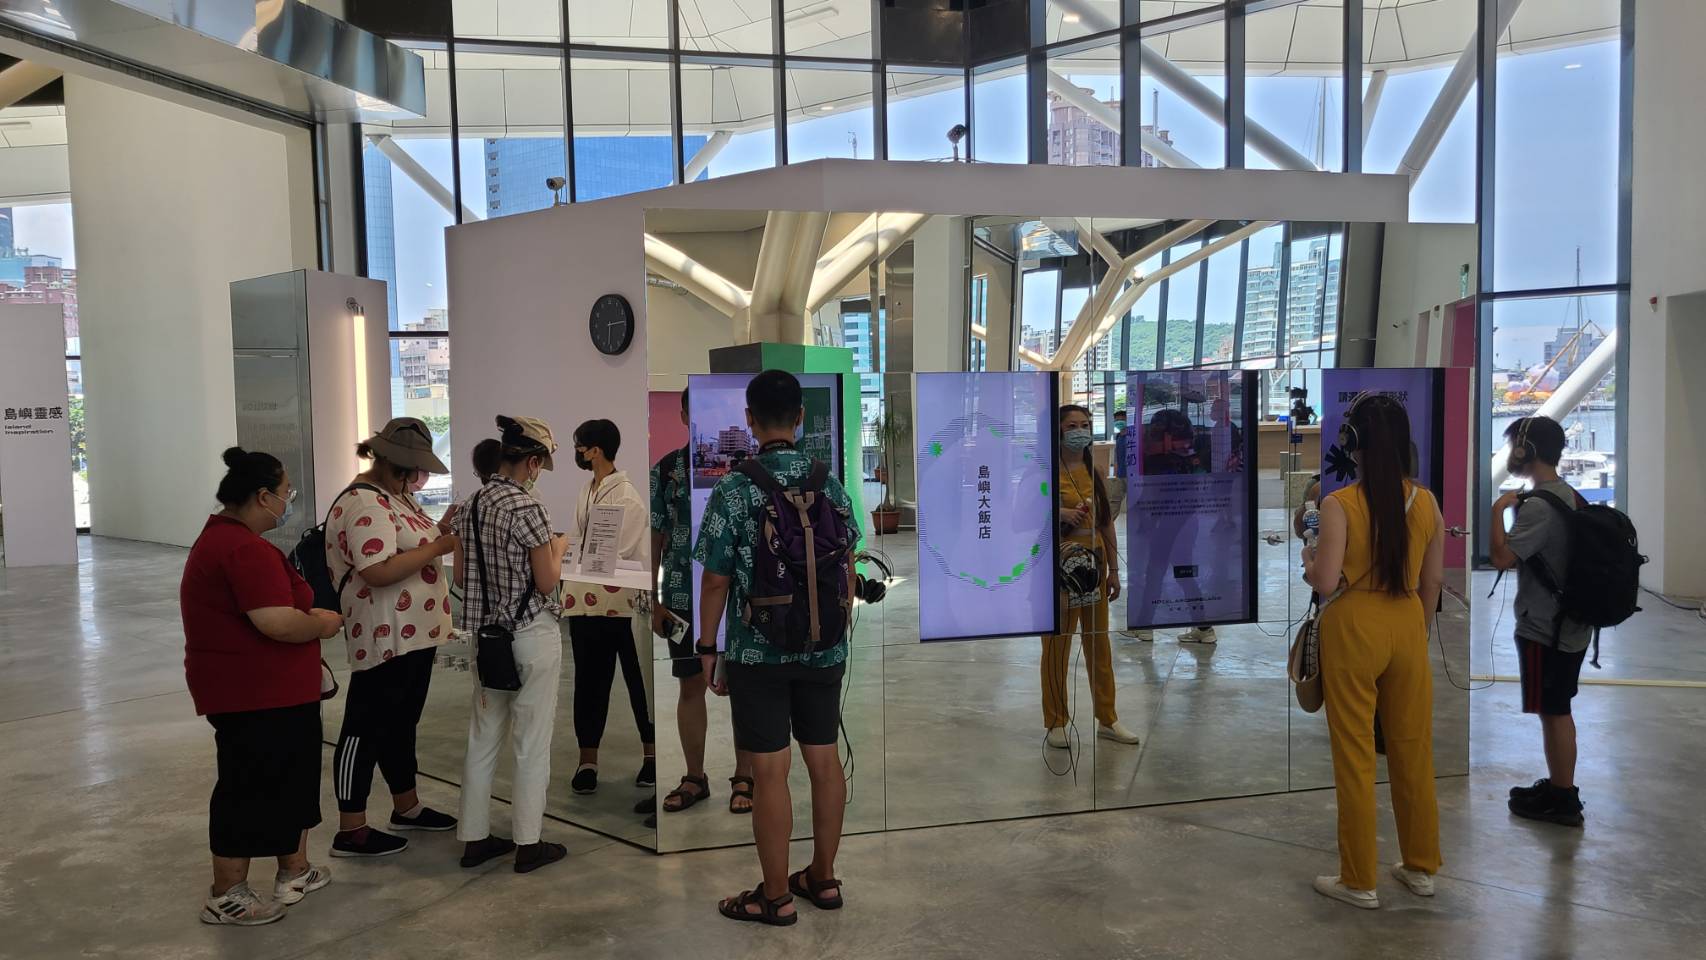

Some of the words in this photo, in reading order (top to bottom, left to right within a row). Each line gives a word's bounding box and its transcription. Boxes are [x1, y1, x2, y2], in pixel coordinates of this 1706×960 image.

[4, 407, 63, 420] 島嶼靈感
[977, 465, 991, 539] 島嶼大飯店
